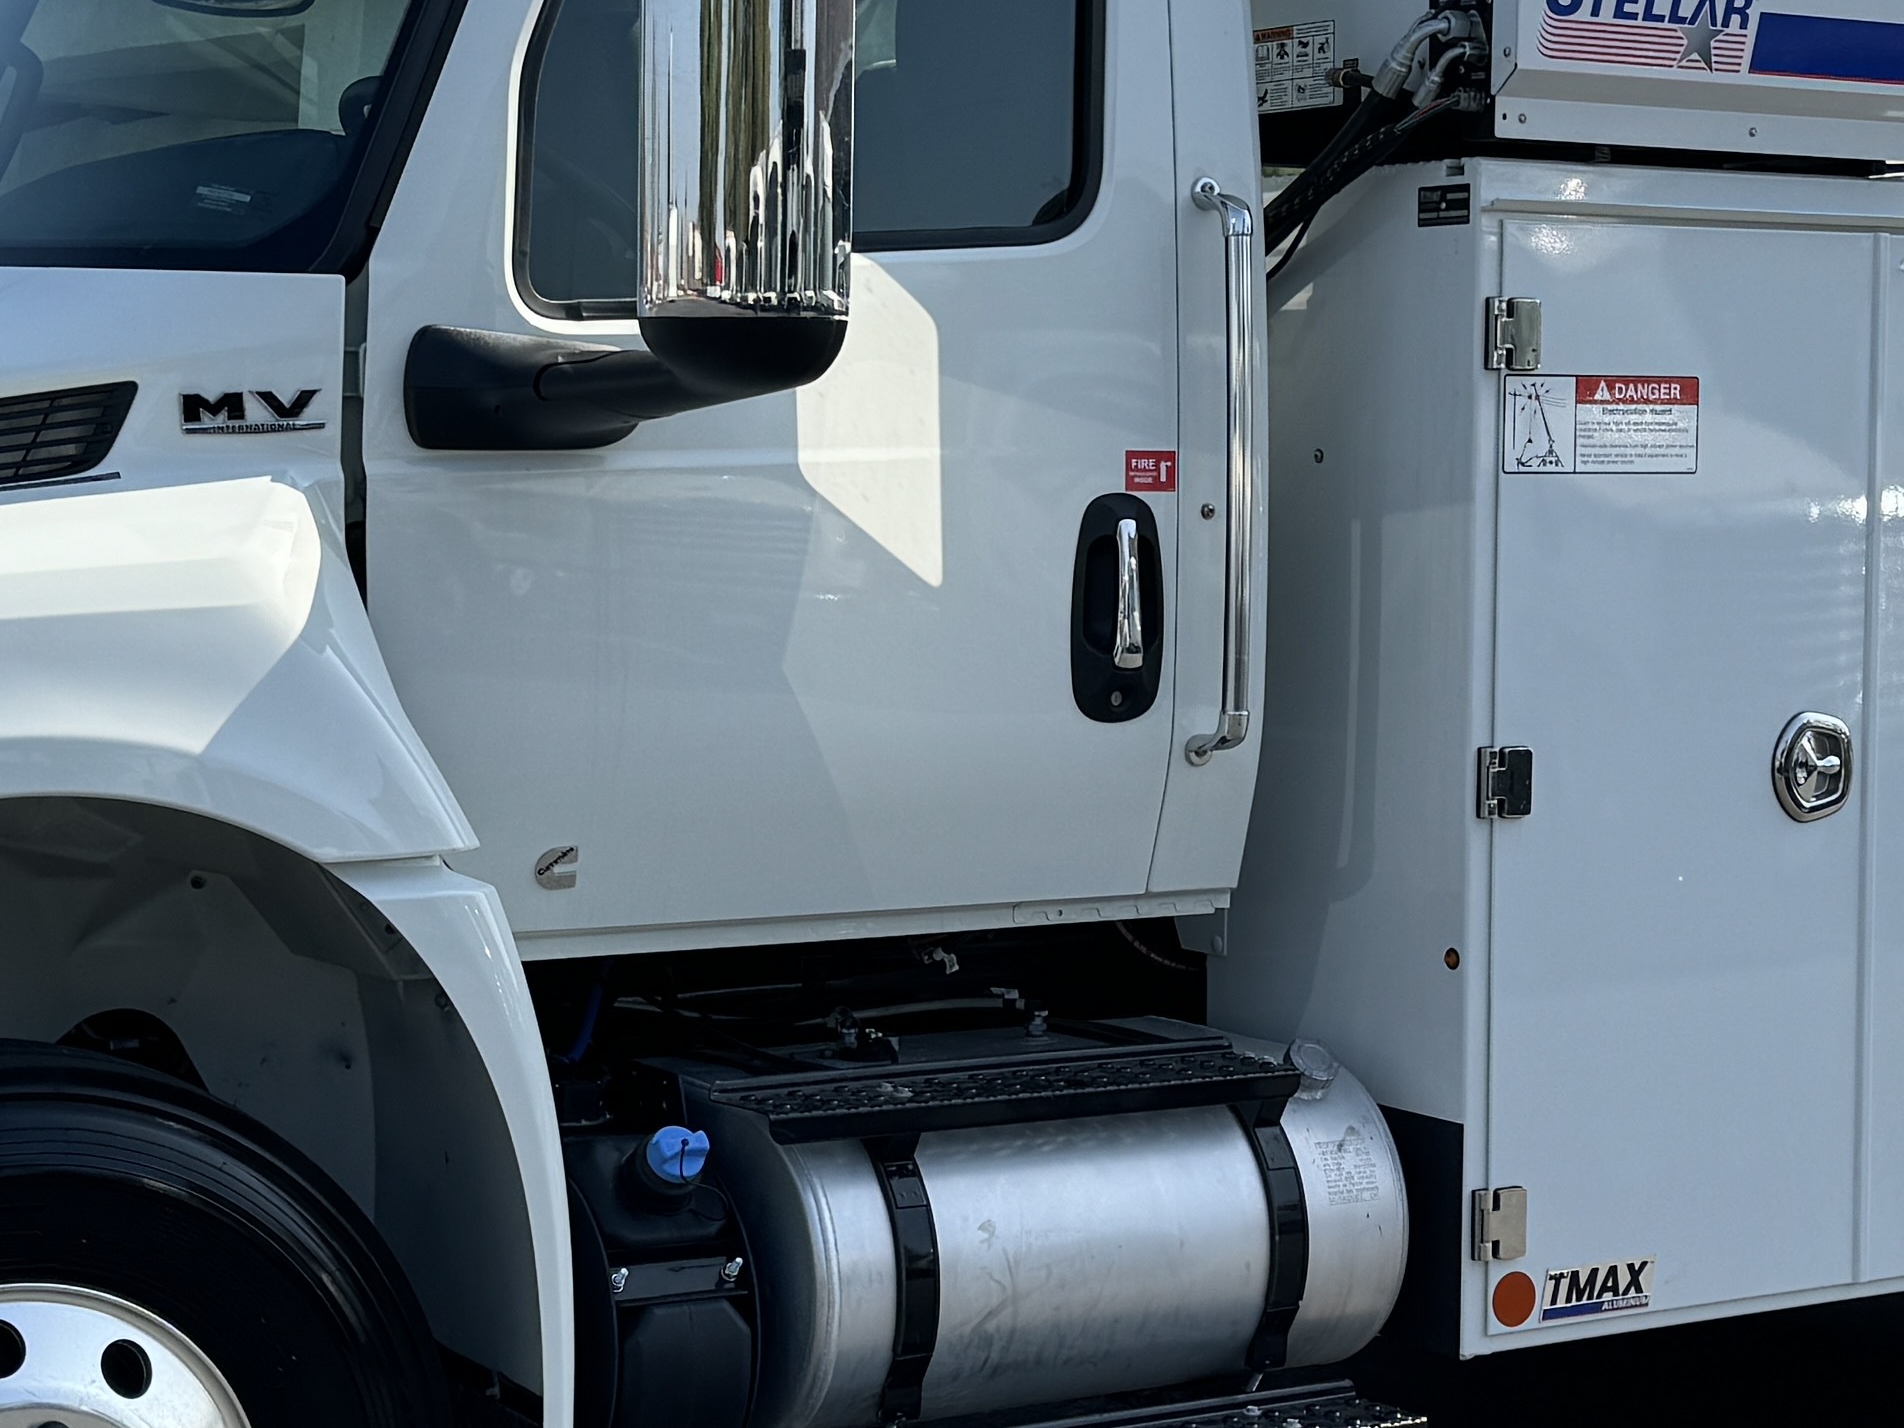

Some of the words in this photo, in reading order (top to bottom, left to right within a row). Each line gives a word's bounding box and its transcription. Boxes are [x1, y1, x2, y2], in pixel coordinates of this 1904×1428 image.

[1615, 383, 1681, 400] DANGER
[180, 388, 322, 423] MV
[1131, 459, 1157, 470] FIRE
[1549, 1260, 1650, 1307] TMAX
